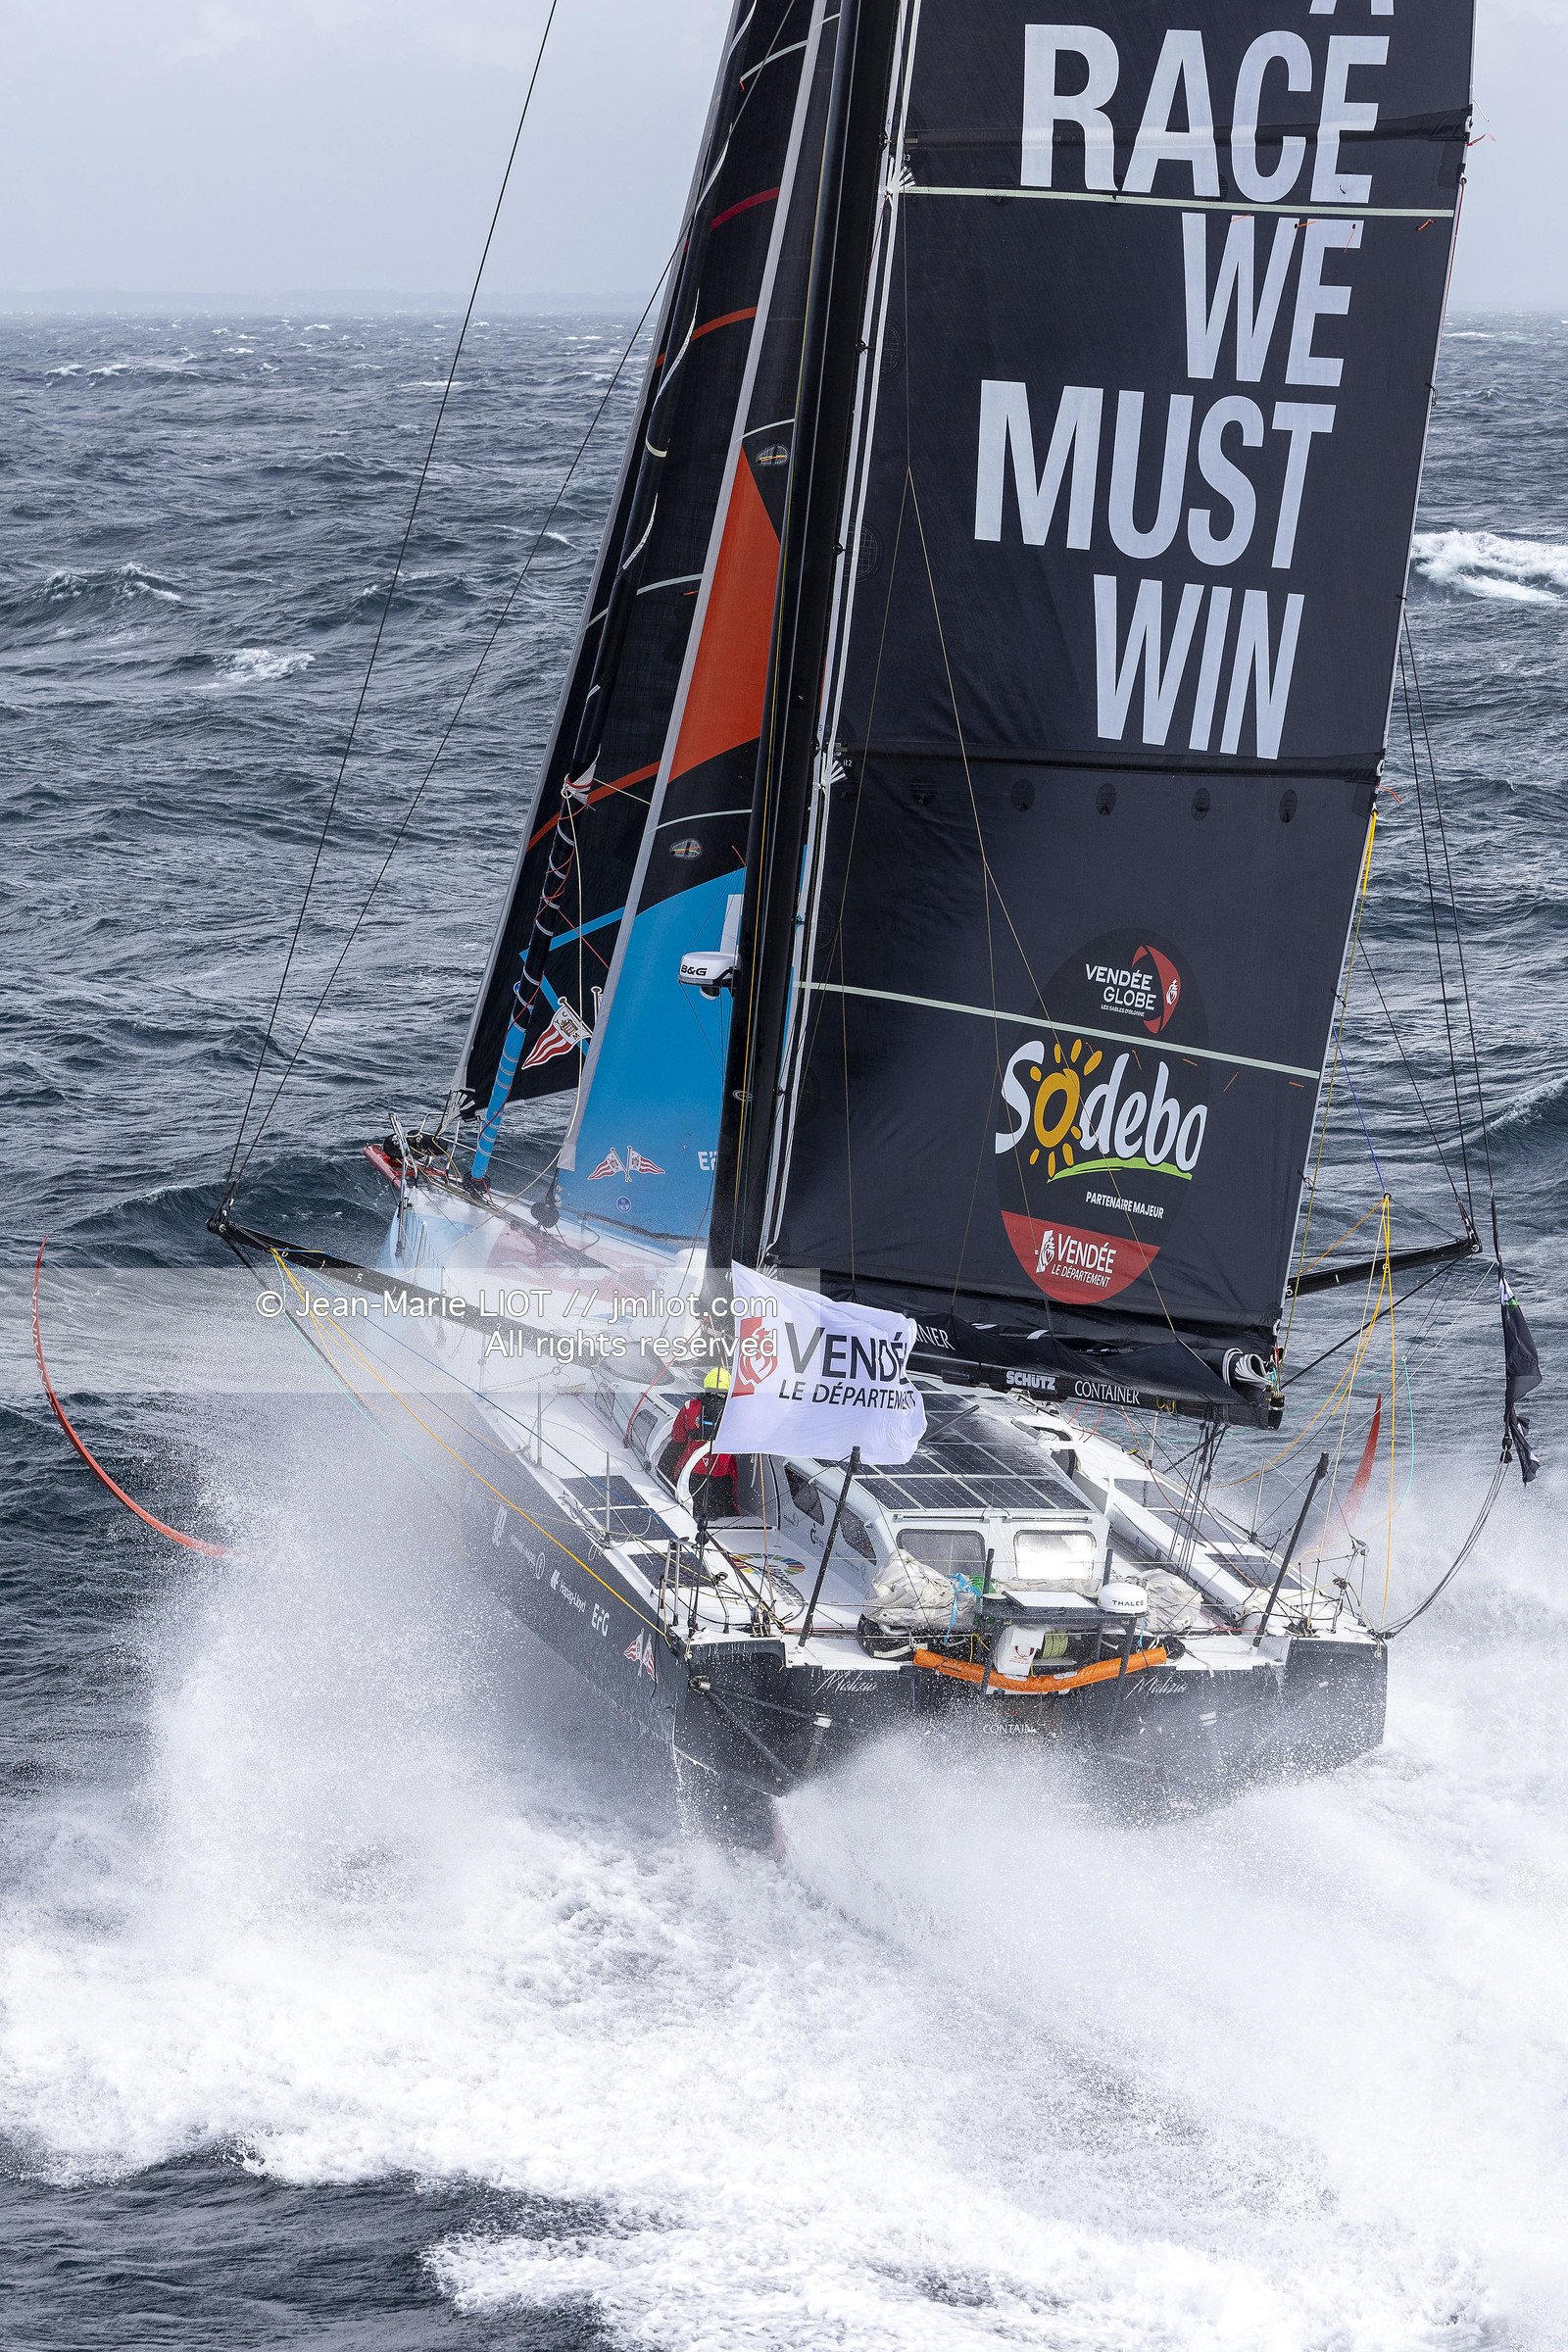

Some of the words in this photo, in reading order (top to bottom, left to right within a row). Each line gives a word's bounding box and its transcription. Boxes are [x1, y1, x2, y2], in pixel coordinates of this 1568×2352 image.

[1020, 24, 1390, 204] RACE
[1182, 212, 1364, 387] WE
[974, 379, 1337, 569] MUST
[1094, 574, 1304, 760] WIN
[680, 964, 708, 976] B&G
[1085, 963, 1153, 991] VENDÉE
[1103, 986, 1156, 1010] GLOBE
[995, 1040, 1207, 1171] Sodebo
[1085, 1191, 1134, 1212] PARTENAIRE
[1133, 1200, 1164, 1219] MAJEUR
[1058, 1233, 1117, 1274] VENDÉE
[1051, 1263, 1060, 1276] LE
[1060, 1266, 1111, 1288] DÉPARTEMENT
[916, 1323, 956, 1351] INER
[778, 1379, 806, 1401] LE
[1005, 1370, 1056, 1391] SCHÜTZ
[1074, 1380, 1140, 1405] CONTAINER
